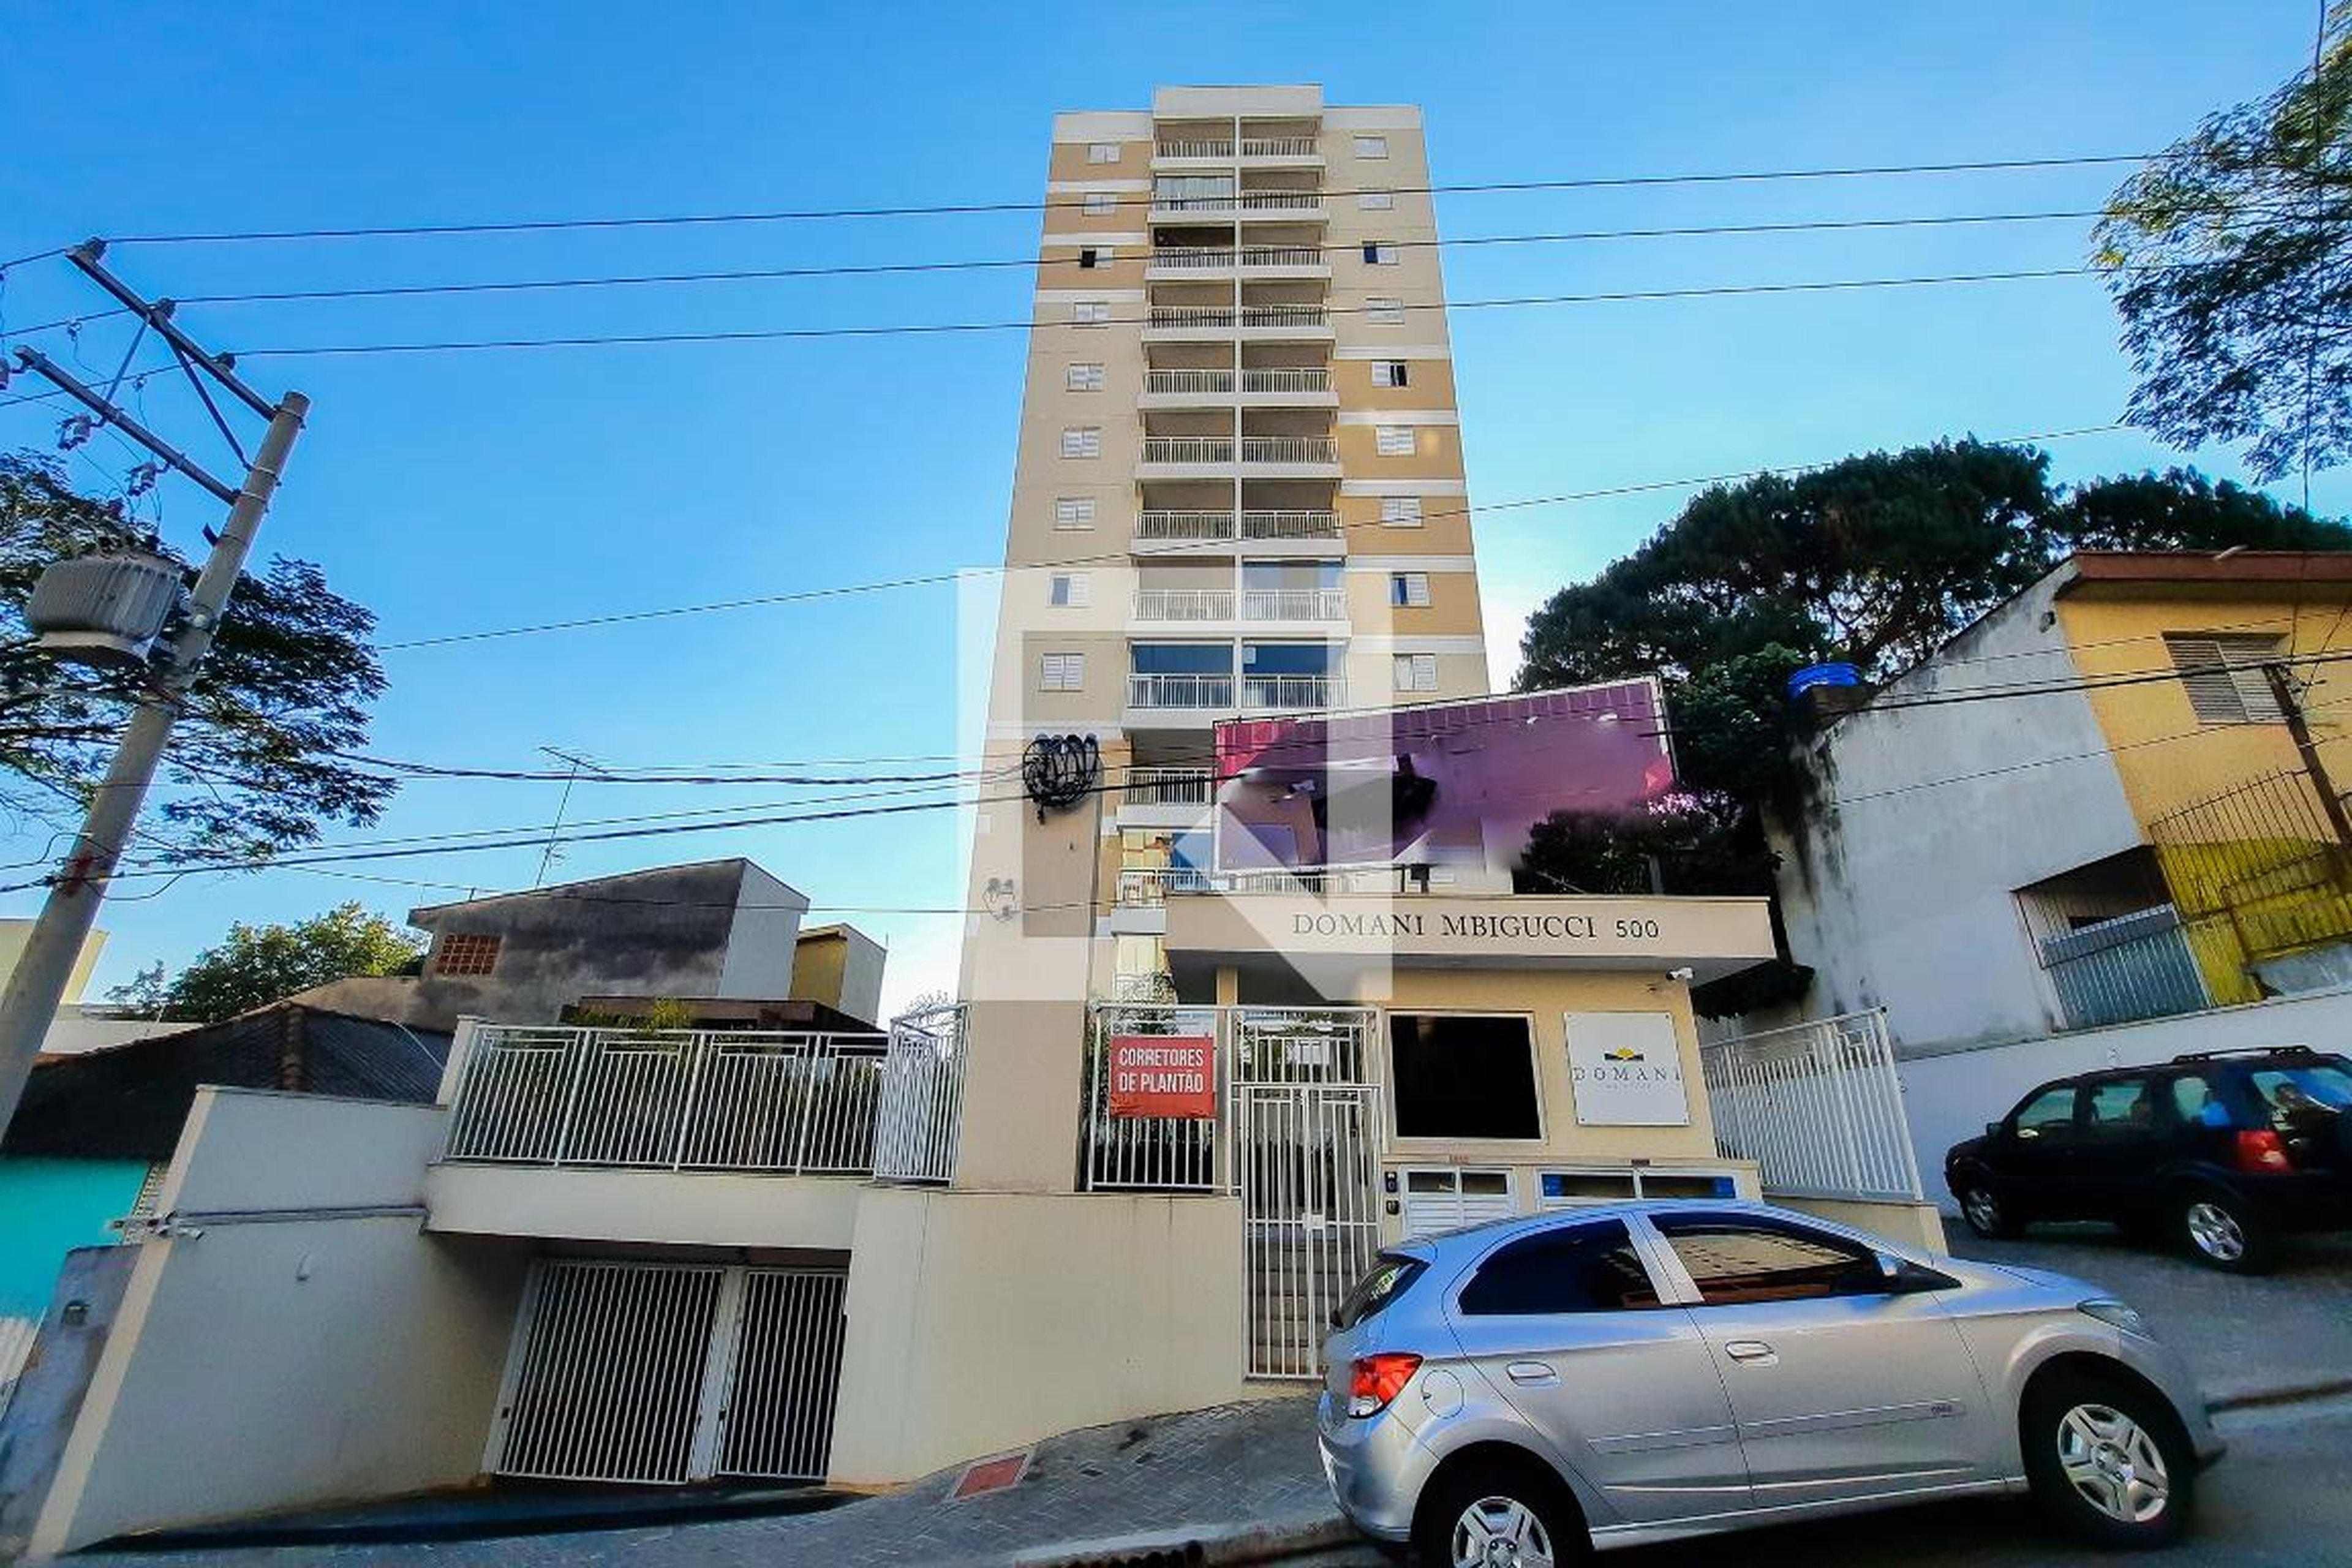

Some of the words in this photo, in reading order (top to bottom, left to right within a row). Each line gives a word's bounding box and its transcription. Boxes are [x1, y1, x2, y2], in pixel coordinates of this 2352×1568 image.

[1292, 914, 1424, 936] DOMANI
[1441, 914, 1597, 938] MBIGUCCI
[1615, 919, 1659, 938] 500
[1119, 1047, 1204, 1067] CORRETORES
[1119, 1072, 1137, 1093] DE
[1140, 1069, 1204, 1093] PLANTÃO
[1572, 1067, 1681, 1082] DOMANI
